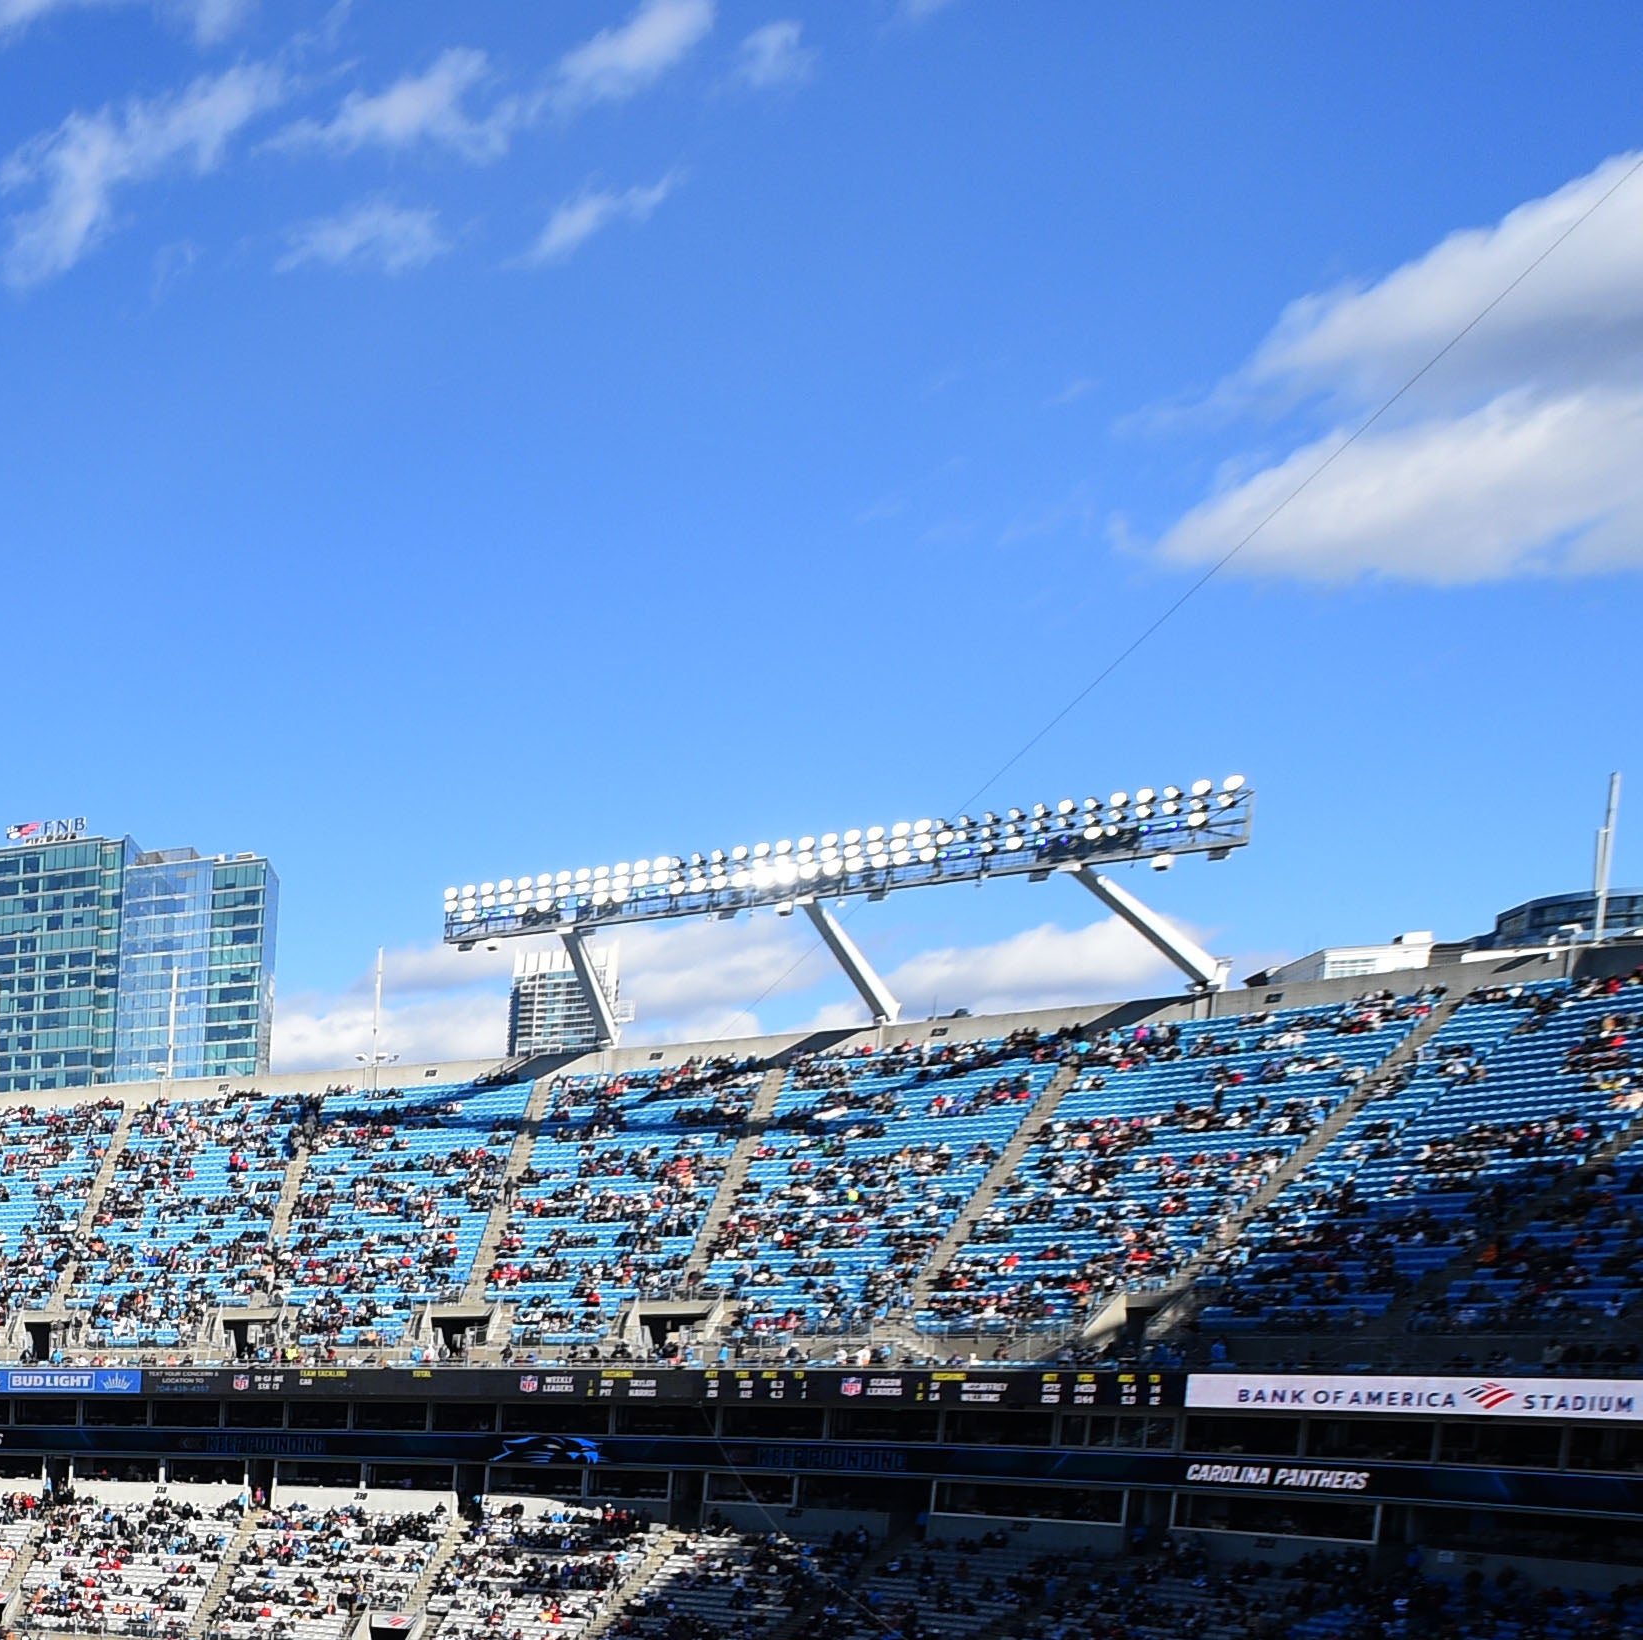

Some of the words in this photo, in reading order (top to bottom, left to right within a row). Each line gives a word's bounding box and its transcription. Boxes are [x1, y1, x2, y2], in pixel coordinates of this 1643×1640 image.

[12, 1374, 44, 1387] BUD
[46, 1374, 91, 1387] LIGHT
[1237, 1388, 1305, 1404] BANK
[1313, 1389, 1344, 1405] OF
[1348, 1391, 1456, 1408] AMERICA
[1522, 1394, 1633, 1414] STADIUM
[1185, 1464, 1272, 1486] CAROLINA
[1273, 1468, 1370, 1490] PANTHERS
